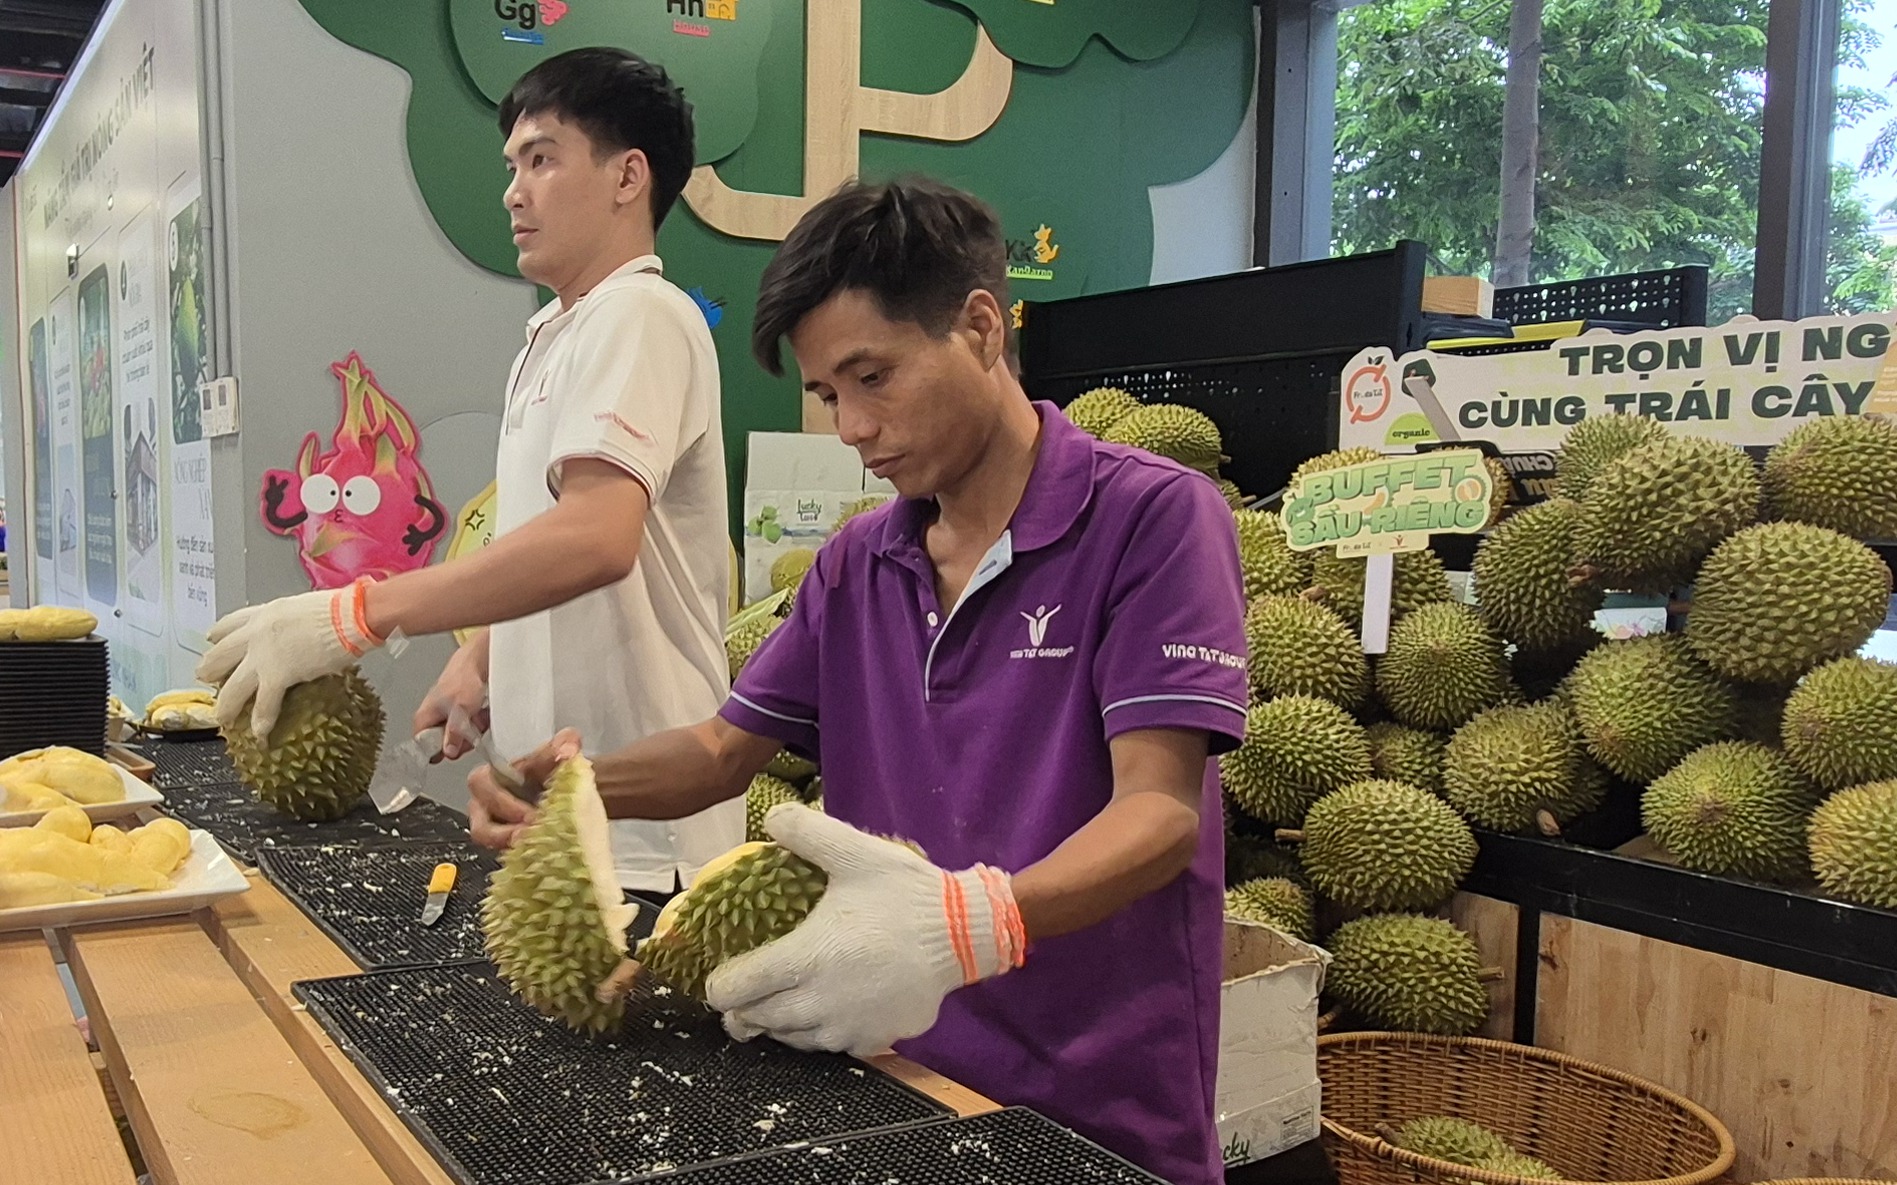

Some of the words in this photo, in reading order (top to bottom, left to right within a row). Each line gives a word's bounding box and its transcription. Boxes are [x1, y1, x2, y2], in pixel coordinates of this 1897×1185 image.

[494, 0, 536, 30] Gg
[1559, 337, 1703, 381] TRỌN
[1723, 331, 1781, 373] VỊ
[1801, 322, 1891, 362] NG
[1458, 391, 1587, 429] CÙNG
[1604, 379, 1731, 422] TRÁI
[1751, 373, 1876, 418] CÂY
[1392, 428, 1431, 440] organic
[1303, 454, 1478, 507] BUFFET
[797, 498, 822, 514] Lucky
[1291, 503, 1362, 545] SẦU
[1370, 496, 1485, 534] RIÊNG
[1222, 1131, 1251, 1165] cky
